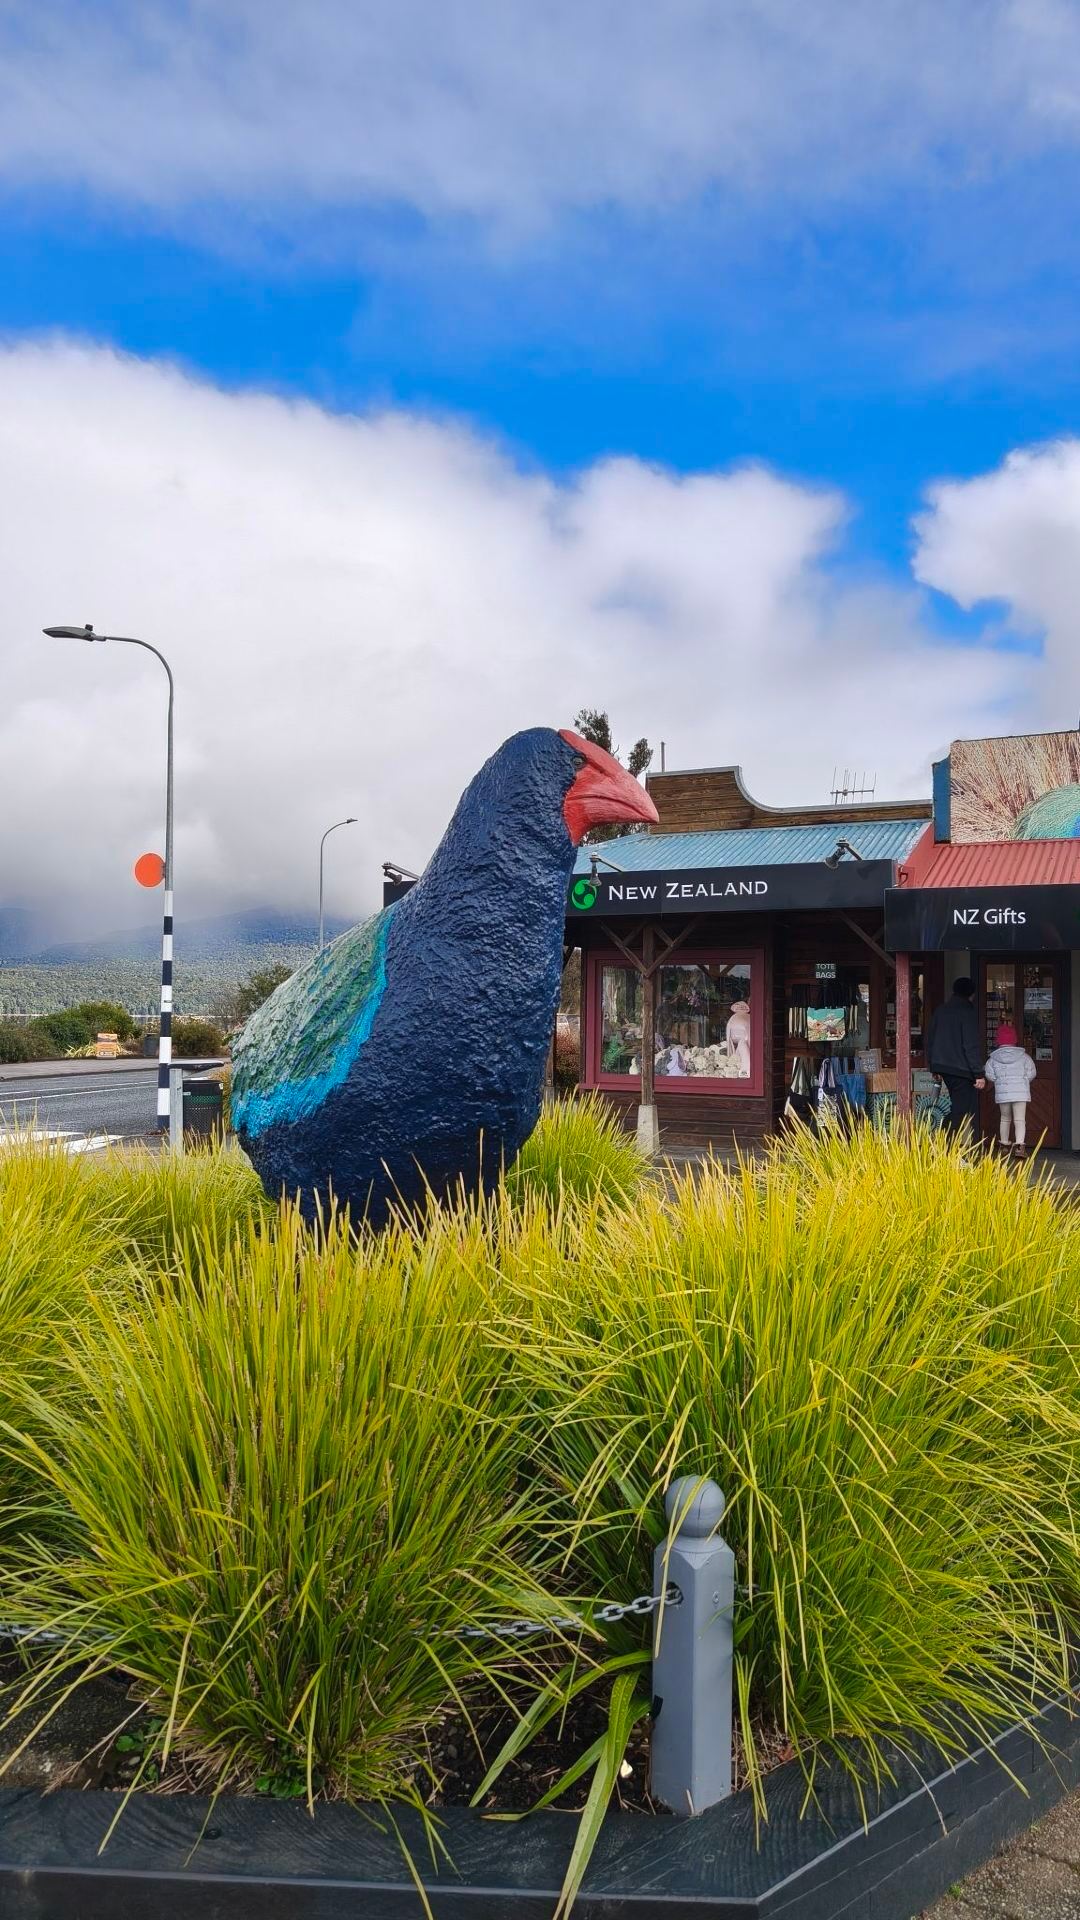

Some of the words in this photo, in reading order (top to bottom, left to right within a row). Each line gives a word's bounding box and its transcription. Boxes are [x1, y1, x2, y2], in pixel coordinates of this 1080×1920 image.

[953, 908, 980, 925] NZ
[984, 907, 1027, 925] Gifts
[815, 971, 837, 979] BAGS
